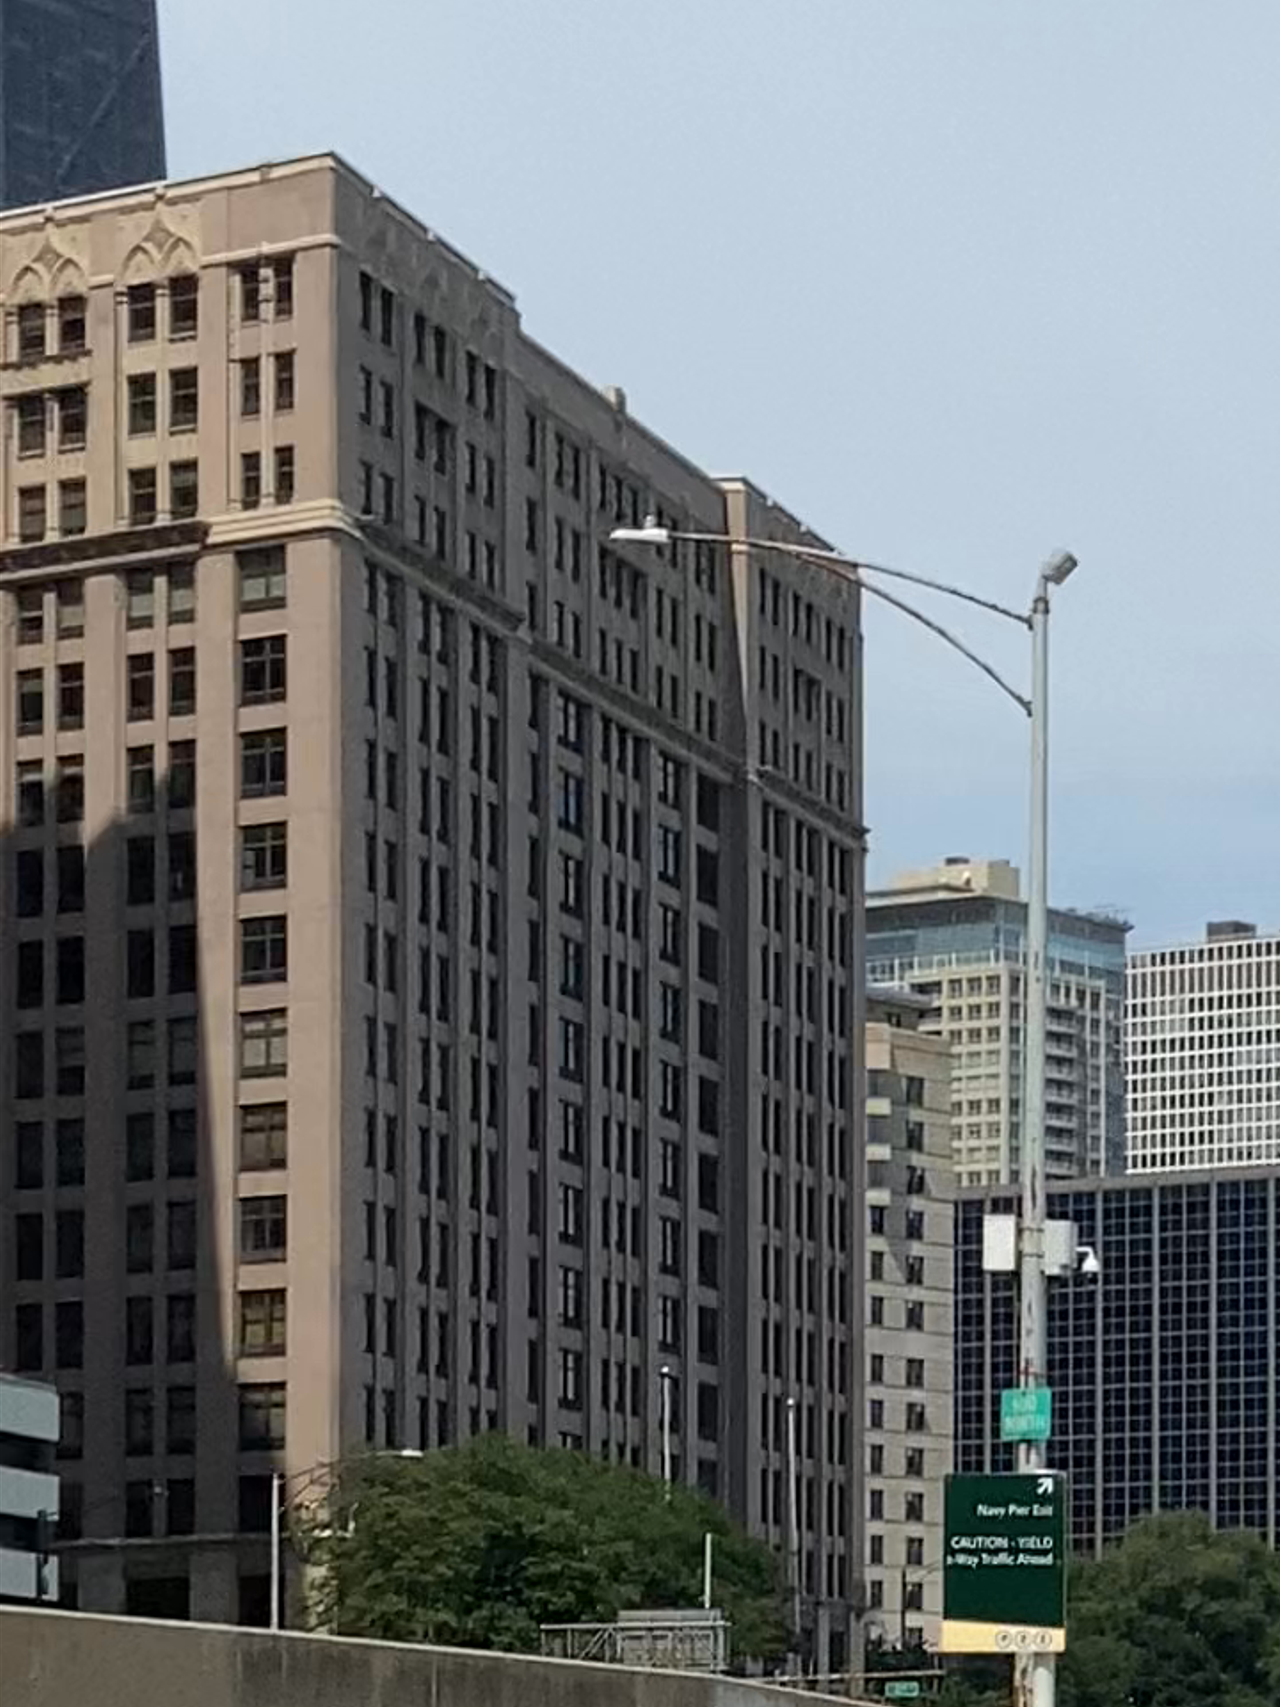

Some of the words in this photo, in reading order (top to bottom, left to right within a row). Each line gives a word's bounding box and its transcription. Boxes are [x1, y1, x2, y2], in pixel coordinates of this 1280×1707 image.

[976, 1503, 1006, 1521] Navy
[1008, 1503, 1031, 1517] Pier
[950, 1535, 1009, 1550] CAUTION
[1017, 1535, 1053, 1550] YIELD
[981, 1552, 1015, 1566] Traffic
[1016, 1552, 1054, 1566] Ahead
